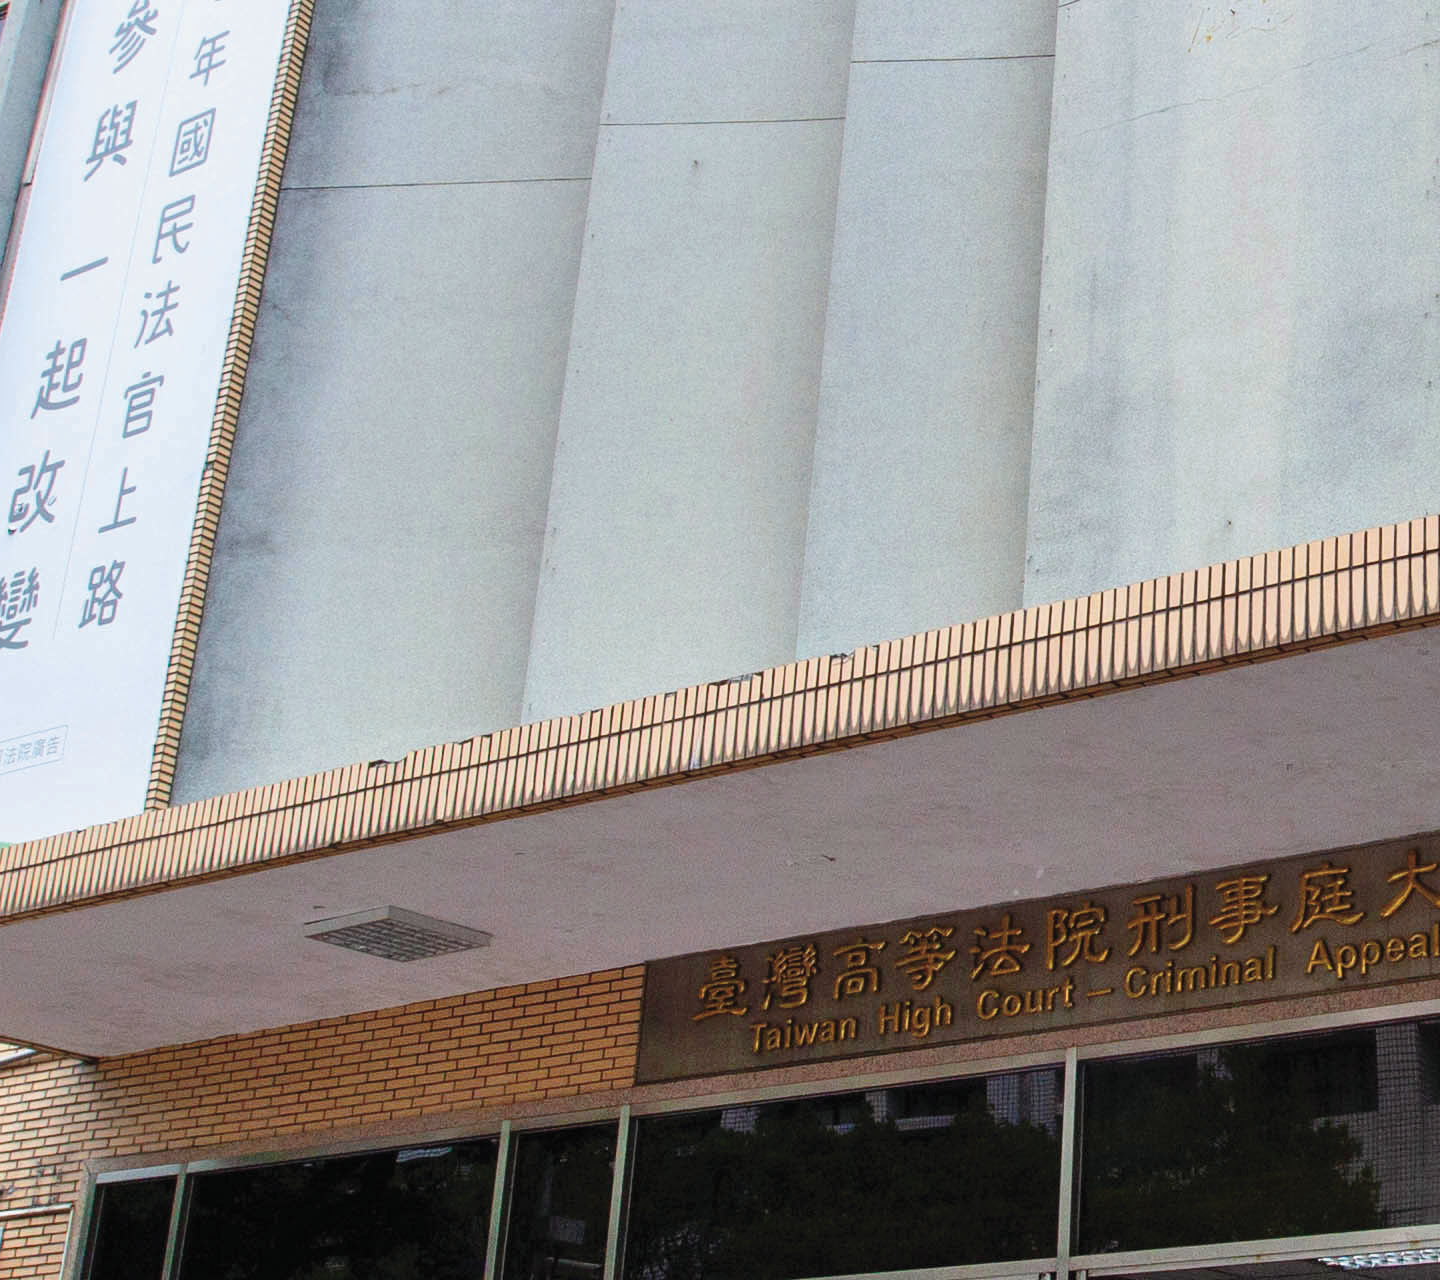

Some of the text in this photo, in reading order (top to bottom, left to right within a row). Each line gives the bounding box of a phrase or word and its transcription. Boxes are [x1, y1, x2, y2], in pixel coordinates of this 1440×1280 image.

[750, 1015, 859, 1054] Taiwan
[878, 994, 954, 1039] High
[977, 977, 1076, 1021] Court
[1124, 945, 1276, 1000] Criminal
